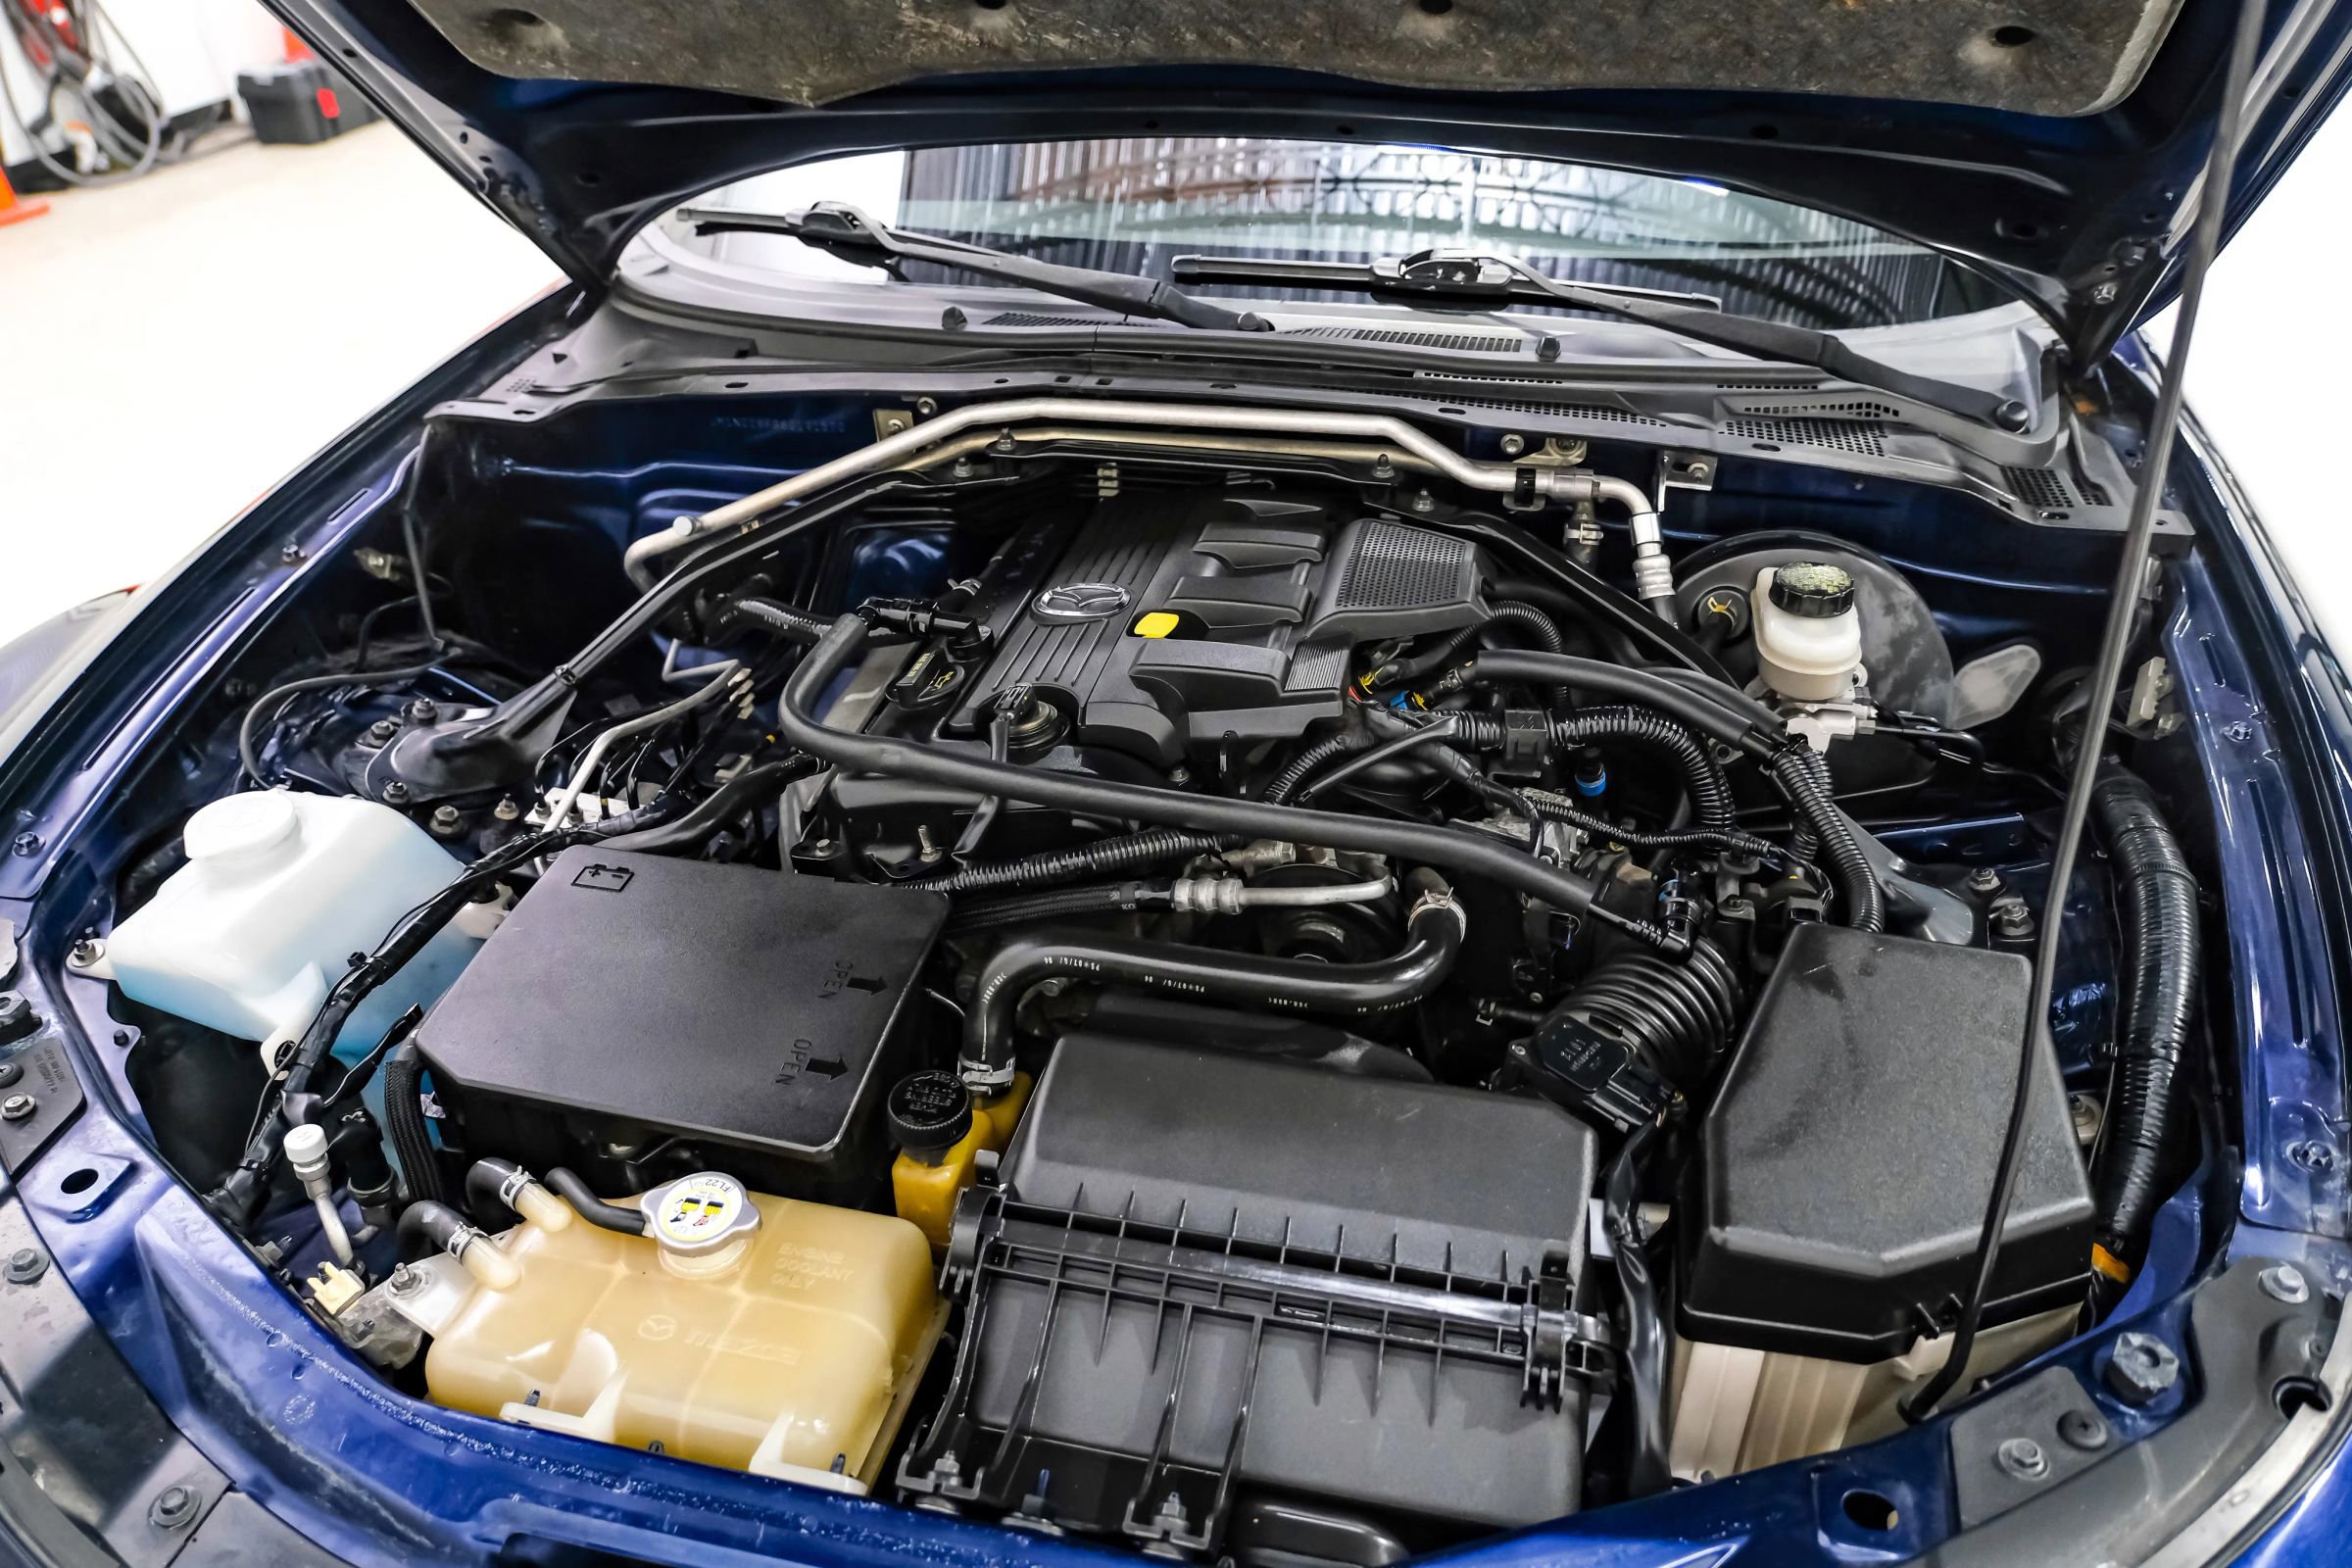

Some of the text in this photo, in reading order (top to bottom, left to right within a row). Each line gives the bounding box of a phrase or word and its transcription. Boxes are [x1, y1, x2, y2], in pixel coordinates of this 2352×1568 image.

[816, 959, 855, 999] OPEN
[774, 1039, 812, 1086] OPEN
[705, 1178, 732, 1193] FL22
[778, 1243, 846, 1266] ENGINE
[774, 1256, 856, 1282] COOLANT
[771, 1272, 817, 1291] ONLY
